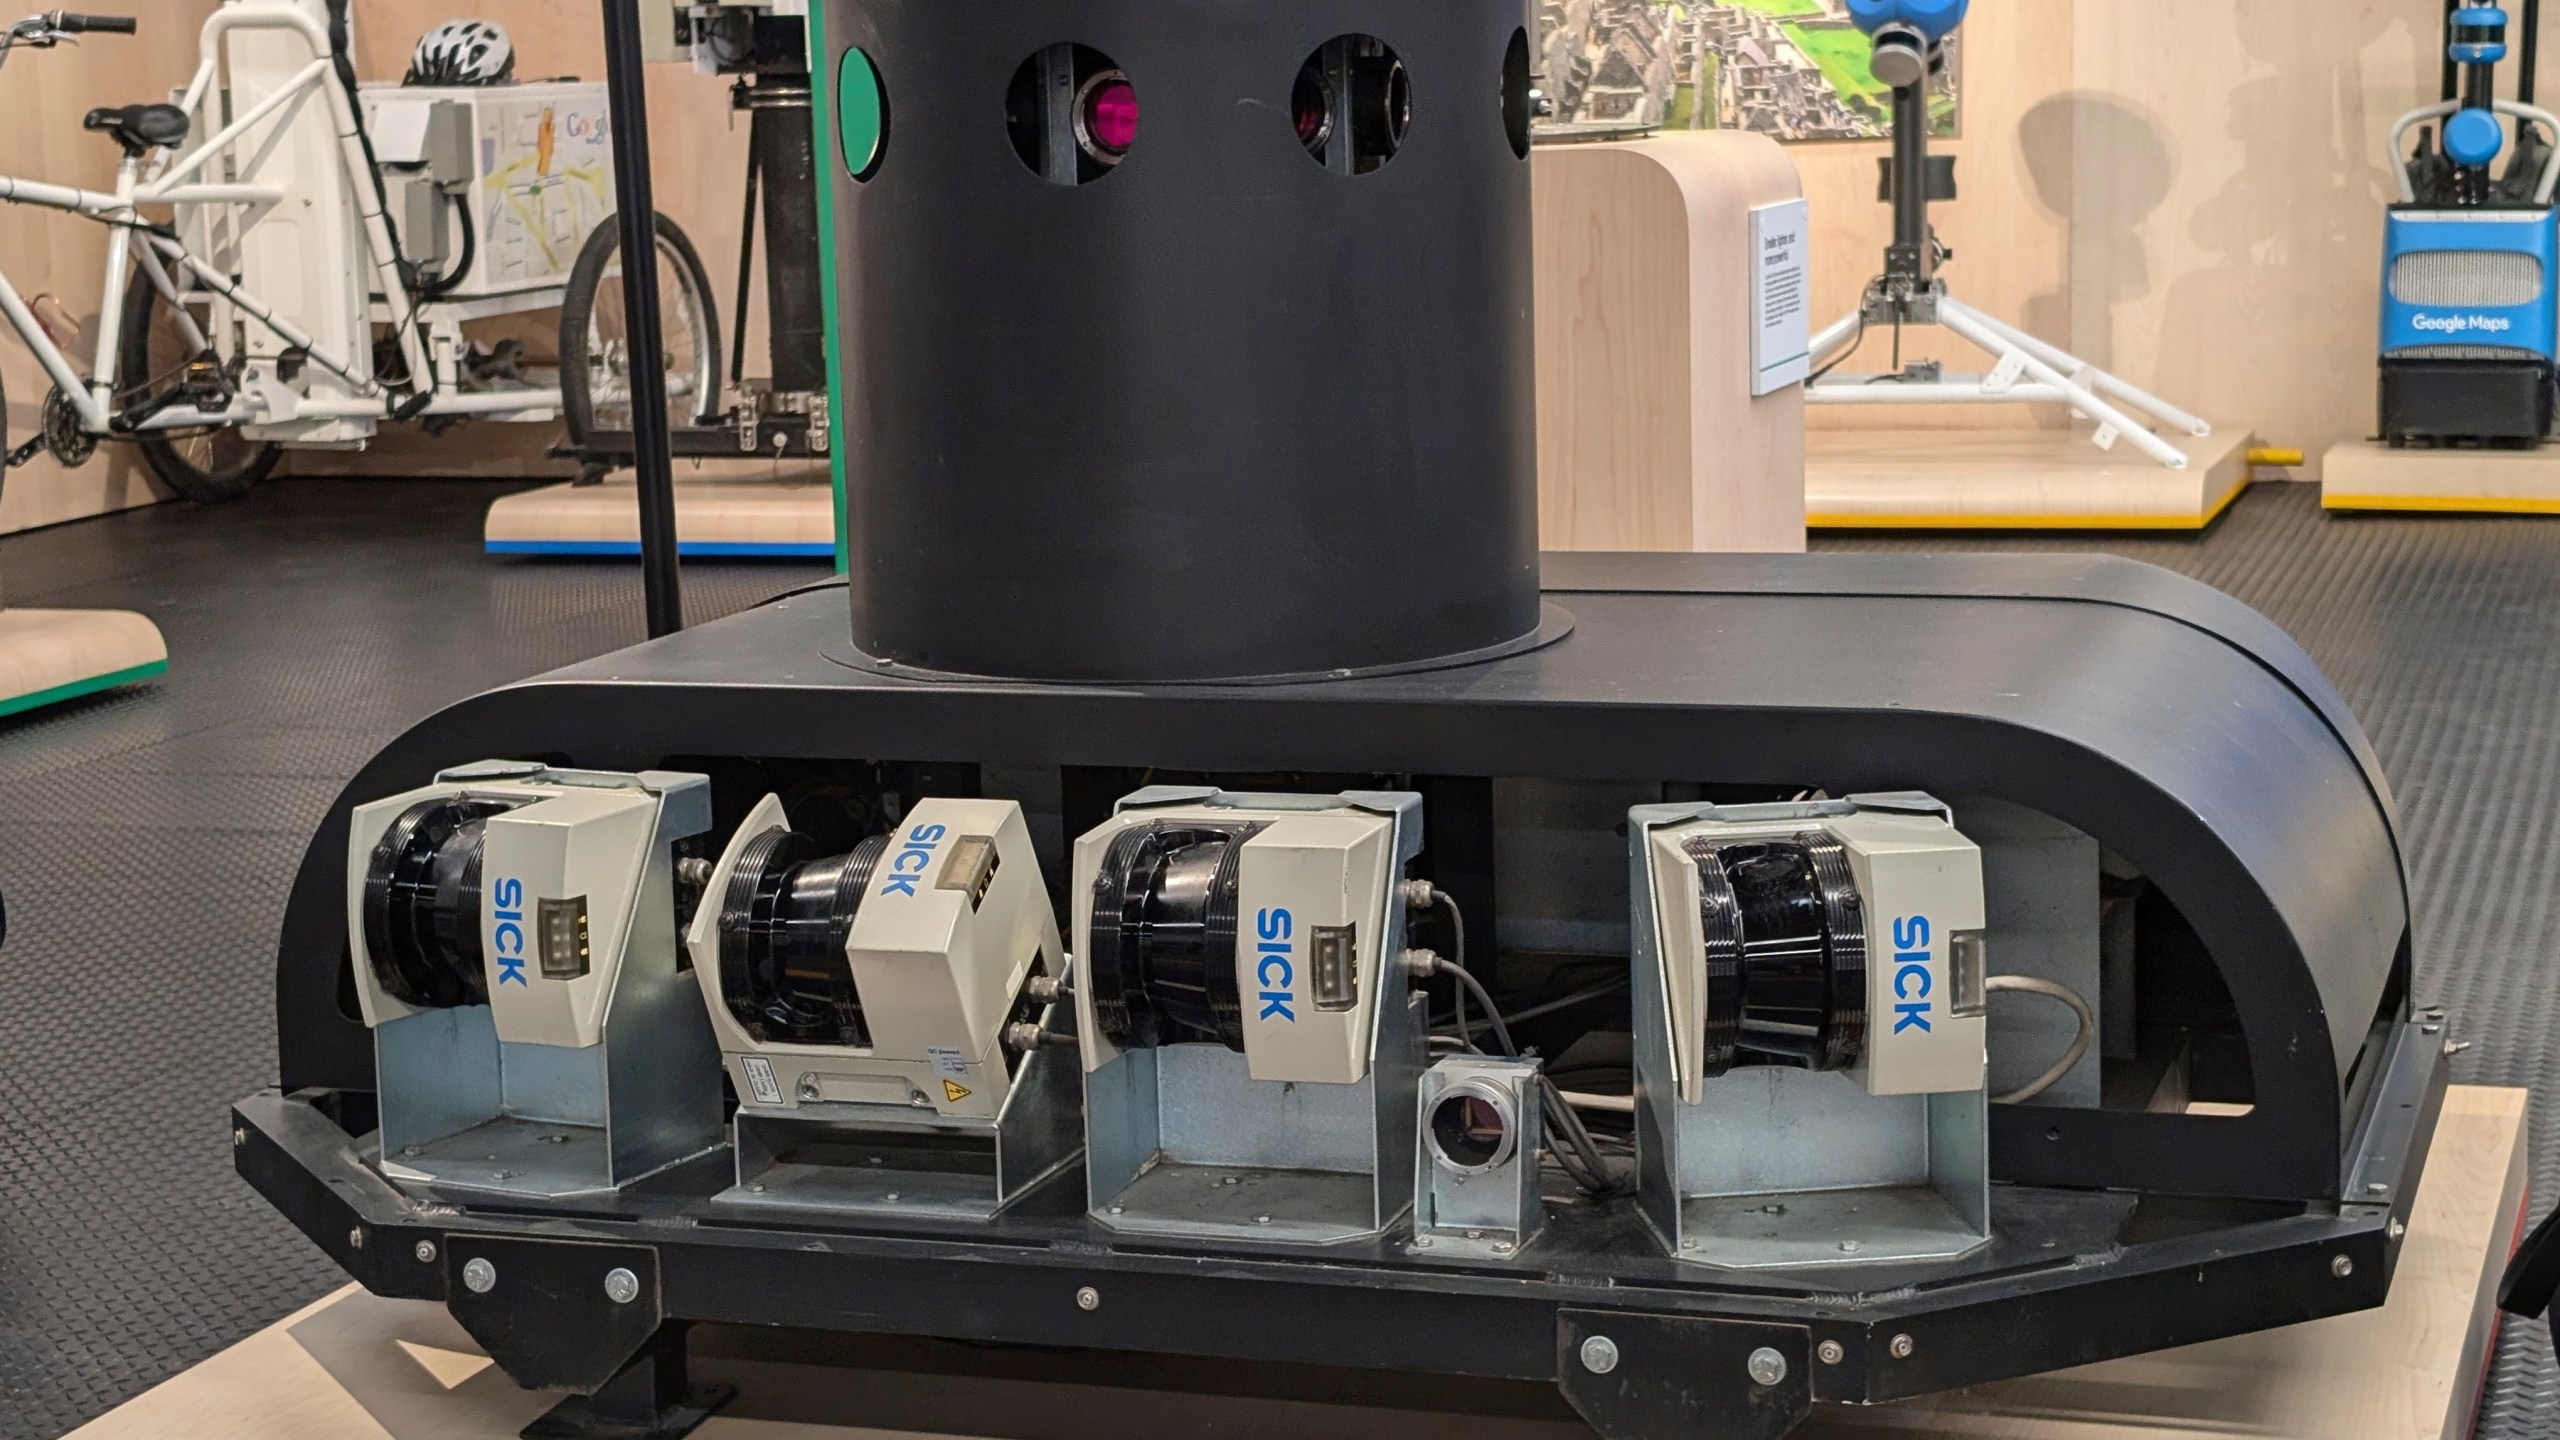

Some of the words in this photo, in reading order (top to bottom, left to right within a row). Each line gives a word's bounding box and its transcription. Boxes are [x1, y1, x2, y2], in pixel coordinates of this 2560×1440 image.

[2412, 312, 2467, 334] Google
[2468, 313, 2510, 333] Maps
[881, 823, 946, 897] SICK
[494, 877, 528, 988] SICK
[1257, 907, 1295, 1023] SICK
[1893, 915, 1932, 1034] SICK
